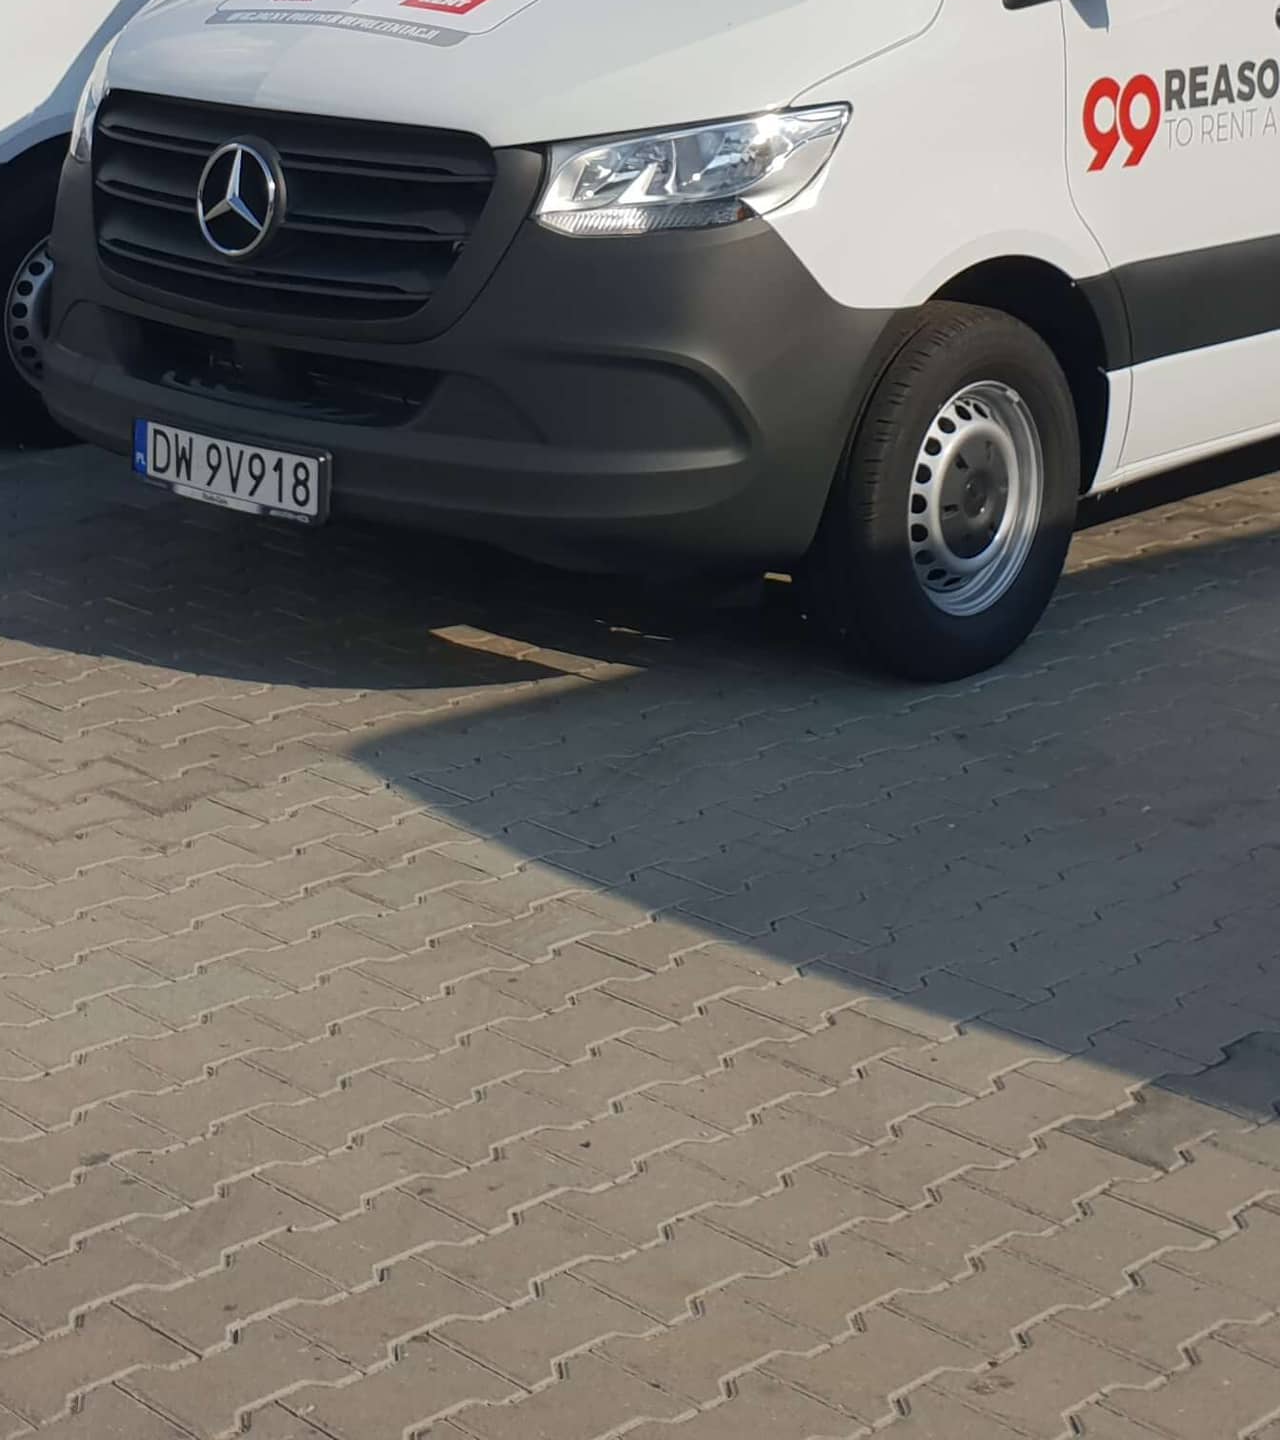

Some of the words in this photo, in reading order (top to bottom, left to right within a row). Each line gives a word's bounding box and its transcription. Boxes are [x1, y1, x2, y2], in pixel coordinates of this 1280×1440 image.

[1082, 74, 1161, 172] 99
[1165, 116, 1193, 148] TO
[1201, 109, 1257, 143] RENT
[1262, 109, 1277, 134] A
[152, 428, 194, 481] DW
[206, 442, 311, 507] 9V918
